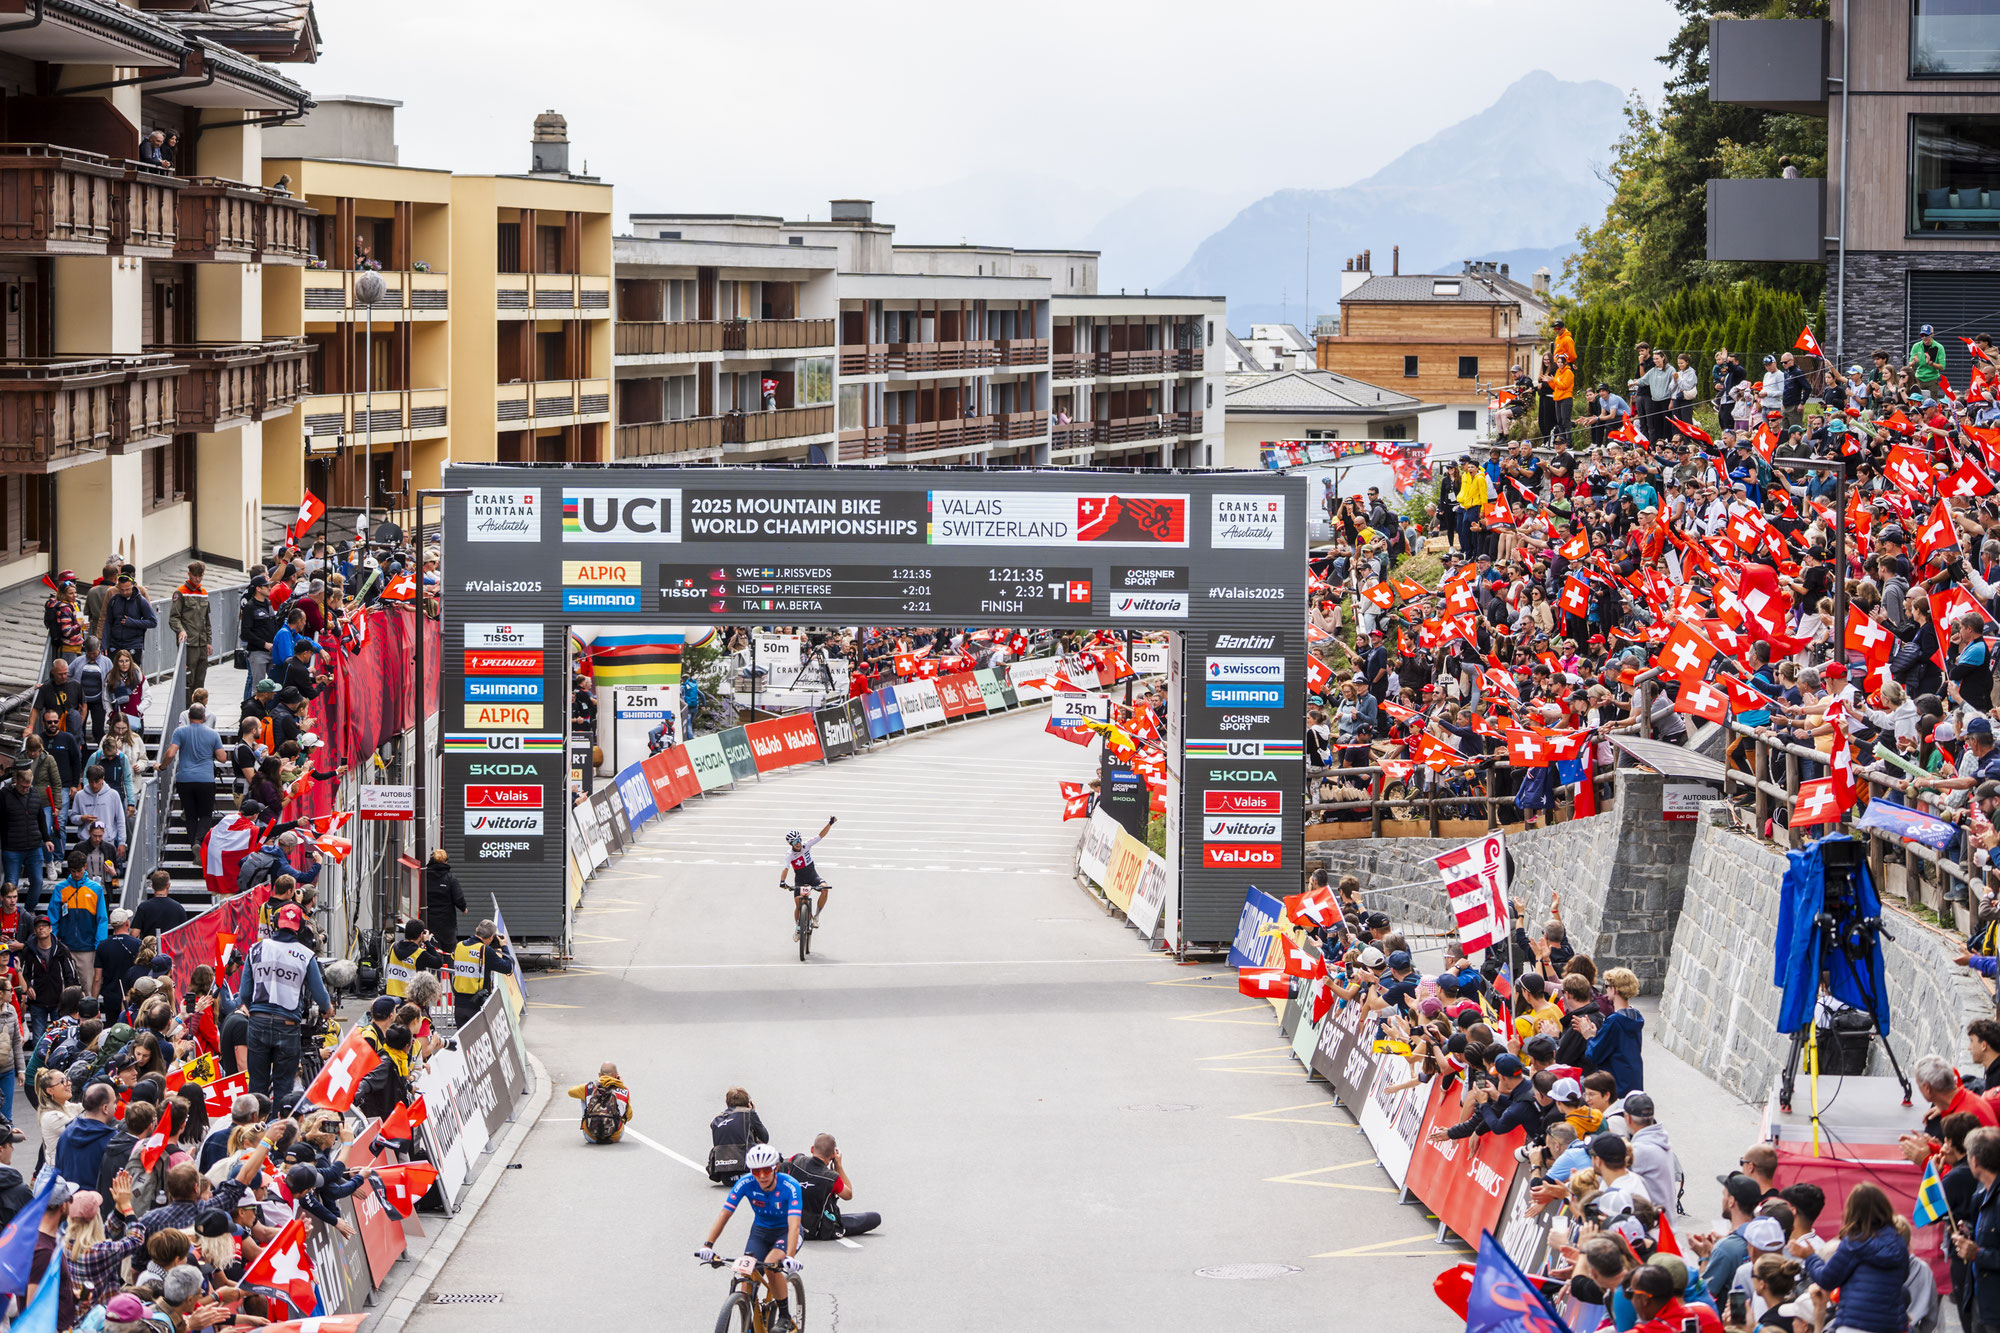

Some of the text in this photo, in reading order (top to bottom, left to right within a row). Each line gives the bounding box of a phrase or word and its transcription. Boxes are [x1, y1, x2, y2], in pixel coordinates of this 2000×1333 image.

[1412, 450, 1426, 458] RTS
[475, 495, 514, 505] CRANS
[475, 506, 534, 516] MONTANA
[691, 498, 880, 515] 2025 MOUNTAIN BIKE
[941, 499, 1003, 515] VALAIS
[1219, 501, 1259, 512] CRANS
[583, 497, 672, 533] UCI
[1219, 512, 1278, 523] MONTANA
[477, 517, 530, 534] Absolutely
[691, 518, 918, 536] WORLD CHAMPIONSHIPS
[941, 520, 1068, 538] SWITZERLAND
[1221, 525, 1273, 541] Absolutely
[578, 566, 626, 582] ALPIQ
[719, 568, 932, 579] 1 SWE J.RISSVEDS 1:21:35
[988, 568, 1044, 582] 1:21:35
[1127, 569, 1175, 579] OCHSNER
[465, 580, 542, 592] #Valais2025
[1124, 577, 1157, 586] SPORT
[660, 588, 708, 598] TISSOT
[718, 585, 932, 595] 6 NED P.PIETERSE +2:01
[1015, 586, 1044, 597] 2:32
[1209, 586, 1285, 600] #Valais2025
[568, 594, 636, 606] SHIMANO
[719, 600, 931, 612] 7 ITA M.BERTA +2:21
[1133, 598, 1181, 612] vittoria
[981, 600, 1023, 613] FINISH
[483, 634, 525, 642] TISSOT
[1215, 634, 1276, 649] Santini
[763, 643, 790, 653] 50m
[480, 658, 536, 667] SPECIALIZED
[1134, 652, 1160, 662] 50m
[777, 666, 802, 674] CRAN
[1223, 663, 1280, 675] swisscom
[470, 684, 538, 695] SHIMANO
[626, 695, 658, 707] 25m
[1211, 690, 1279, 702] SHIMANO
[1065, 702, 1097, 715] 25m
[479, 708, 529, 725] ALPIQ
[622, 711, 663, 719] SHIMANO
[1222, 714, 1270, 724] OCHSNER
[1220, 723, 1252, 731] SPORT
[487, 736, 520, 750] UCI
[751, 728, 817, 757] ValJob ValJob
[1227, 743, 1260, 756] UCI
[495, 790, 529, 802] Valais
[1234, 796, 1267, 807] Valais
[487, 816, 537, 830] vittoria
[1226, 822, 1276, 835] vittoria
[482, 841, 530, 850] OCHSNER
[479, 850, 512, 858] SPORT
[1210, 850, 1275, 863] ValJob
[292, 950, 307, 962] UC
[1319, 1021, 1345, 1061] SPORT
[466, 1031, 496, 1081] OCHSNER
[1343, 1047, 1369, 1092] SPORT
[476, 1073, 499, 1119] SPORT
[1466, 1156, 1504, 1198] S-WORKS
[738, 1259, 751, 1268] 13
